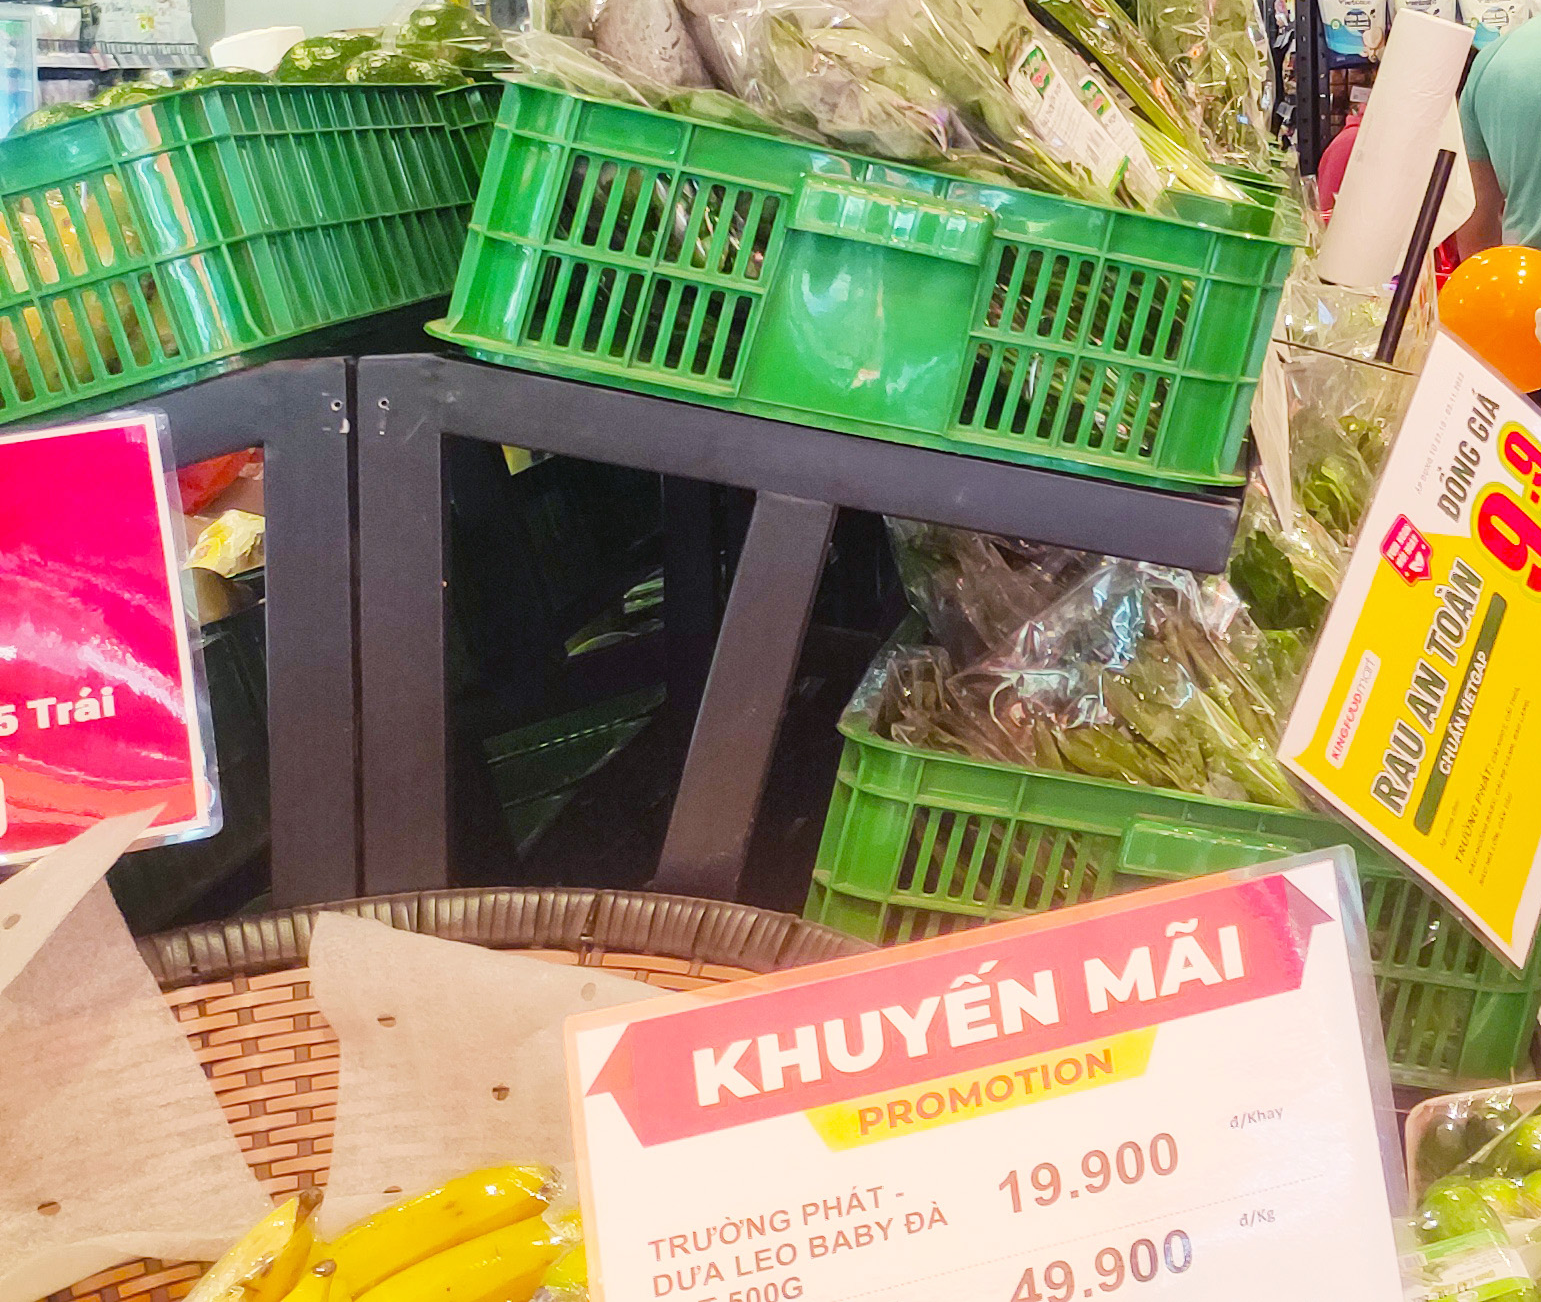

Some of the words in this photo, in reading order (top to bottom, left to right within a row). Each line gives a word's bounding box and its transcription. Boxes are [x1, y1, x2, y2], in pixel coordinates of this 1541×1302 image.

[1436, 439, 1482, 524] ĐỒNG
[1466, 392, 1502, 448] GIÁ
[1425, 558, 1484, 668] TOÀN
[27, 686, 117, 731] Trái
[1405, 658, 1450, 736] AN
[1454, 650, 1489, 717] VIETGAP
[1371, 735, 1426, 819] RAU
[1438, 702, 1471, 776] CHUẨN
[692, 959, 1062, 1107] KHUYẾN
[1083, 918, 1247, 1015] MÃI
[858, 1048, 1117, 1136] PROMOTION
[1229, 1107, 1284, 1130] đ/Khay
[998, 1132, 1179, 1213] 19.900
[648, 1209, 792, 1262] TRƯỜNG
[802, 1185, 884, 1226] PHÁT
[652, 1261, 725, 1298] DƯA
[735, 1243, 798, 1278] LEO
[808, 1217, 894, 1259] BABY
[904, 1200, 948, 1234] ĐÀ
[1239, 1208, 1276, 1229] đ/Kg
[1010, 1229, 1193, 1302] 49.900
